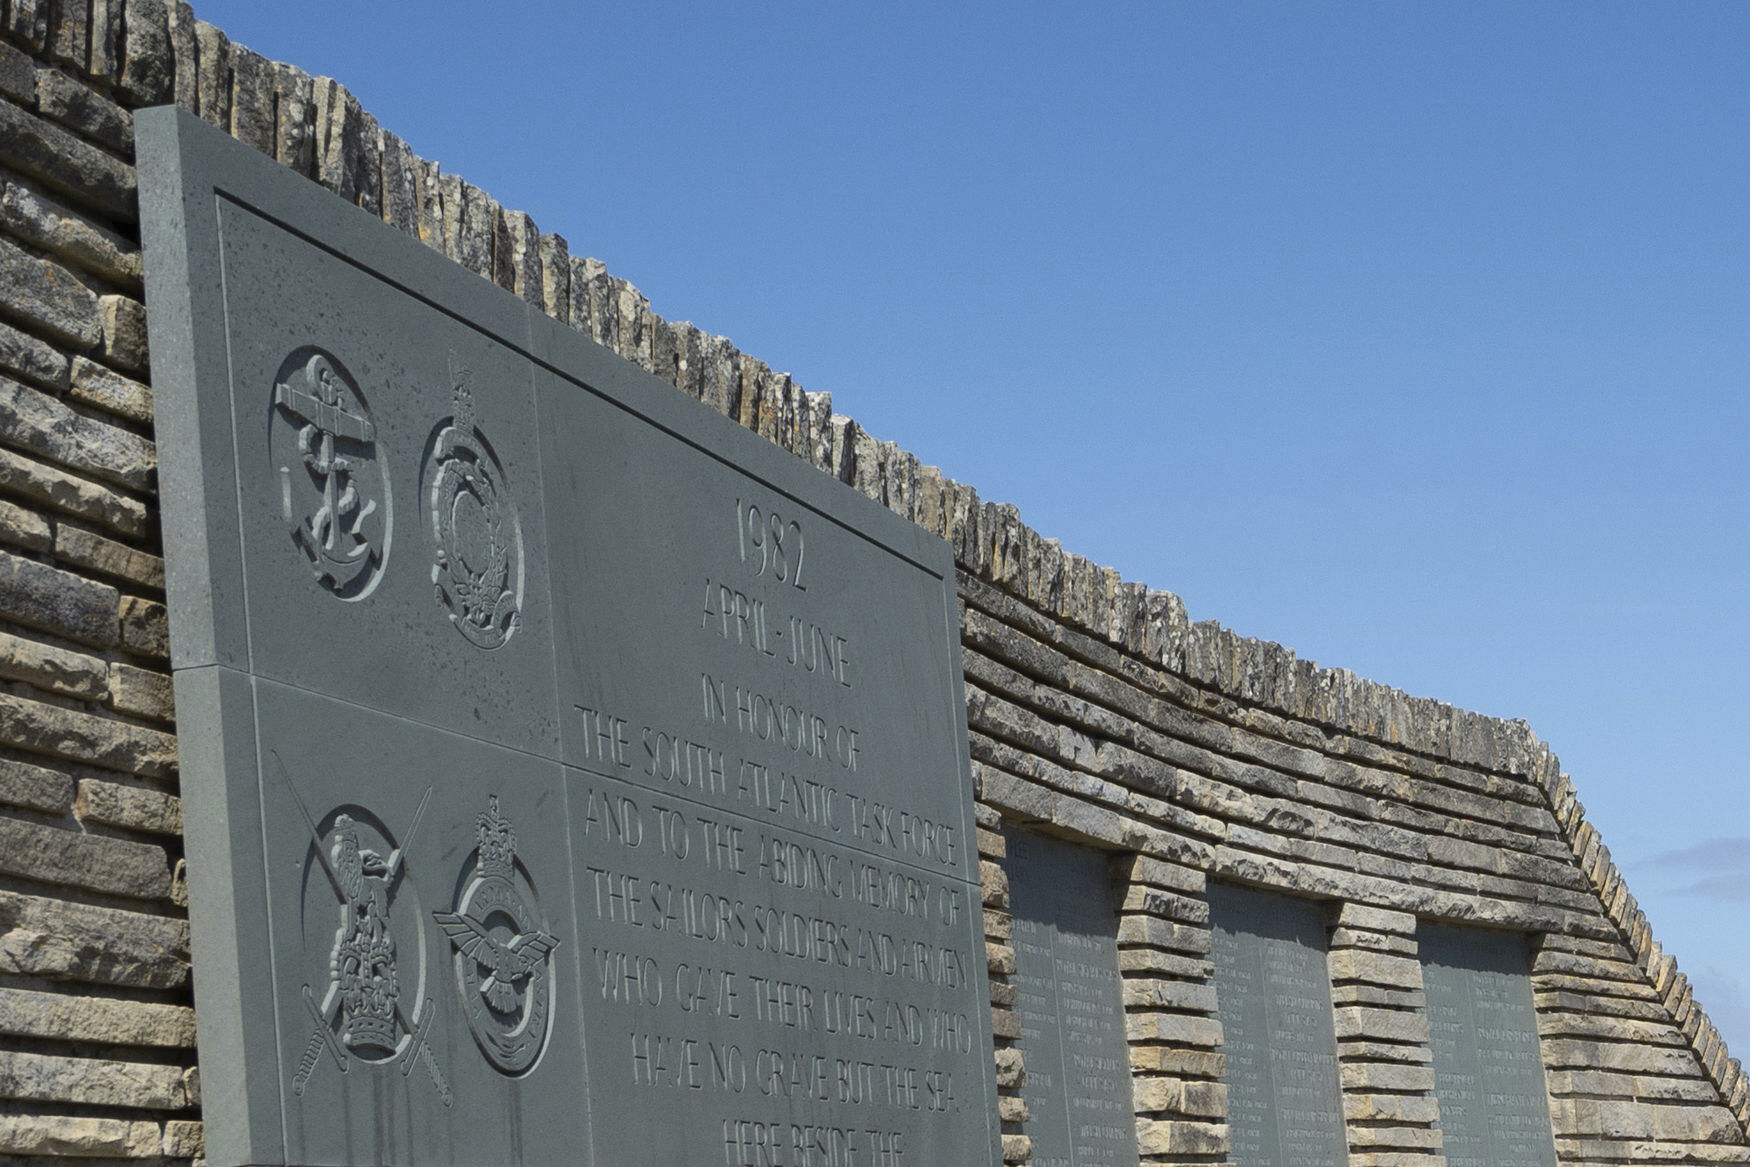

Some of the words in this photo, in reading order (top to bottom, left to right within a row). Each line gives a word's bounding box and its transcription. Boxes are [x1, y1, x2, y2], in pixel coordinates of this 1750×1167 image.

[736, 498, 808, 593] 1982
[701, 672, 727, 726] IN
[735, 685, 832, 762] HONOUR
[836, 725, 860, 773] OF
[574, 703, 632, 769] THE
[641, 726, 726, 796] SOUTH
[738, 758, 841, 833] ATLANTIC
[846, 793, 897, 850] TASK
[901, 811, 957, 868] FORCE
[584, 787, 643, 849] AND
[652, 805, 689, 861] TO
[697, 817, 747, 876] THE
[759, 834, 843, 899] ABIDING
[850, 860, 930, 920] MEMORY
[939, 886, 961, 928] OF
[587, 866, 644, 928] THE
[651, 880, 748, 949] SAILORS
[753, 904, 852, 968] SOLDIERS
[857, 927, 898, 977] AND
[901, 939, 968, 992] AIRMEN
[593, 947, 662, 1007] WHO
[676, 963, 741, 1020] GAVE
[749, 974, 817, 1032] THEIR
[824, 989, 877, 1041] LIVES
[884, 1000, 922, 1046] AND
[927, 1008, 972, 1056] WHO
[630, 1032, 702, 1091] HAVE
[708, 1041, 746, 1094] NO
[755, 1049, 829, 1103] GRAVE
[836, 1058, 875, 1105] BUT
[880, 1063, 921, 1111] THE
[925, 1070, 960, 1113] SEA
